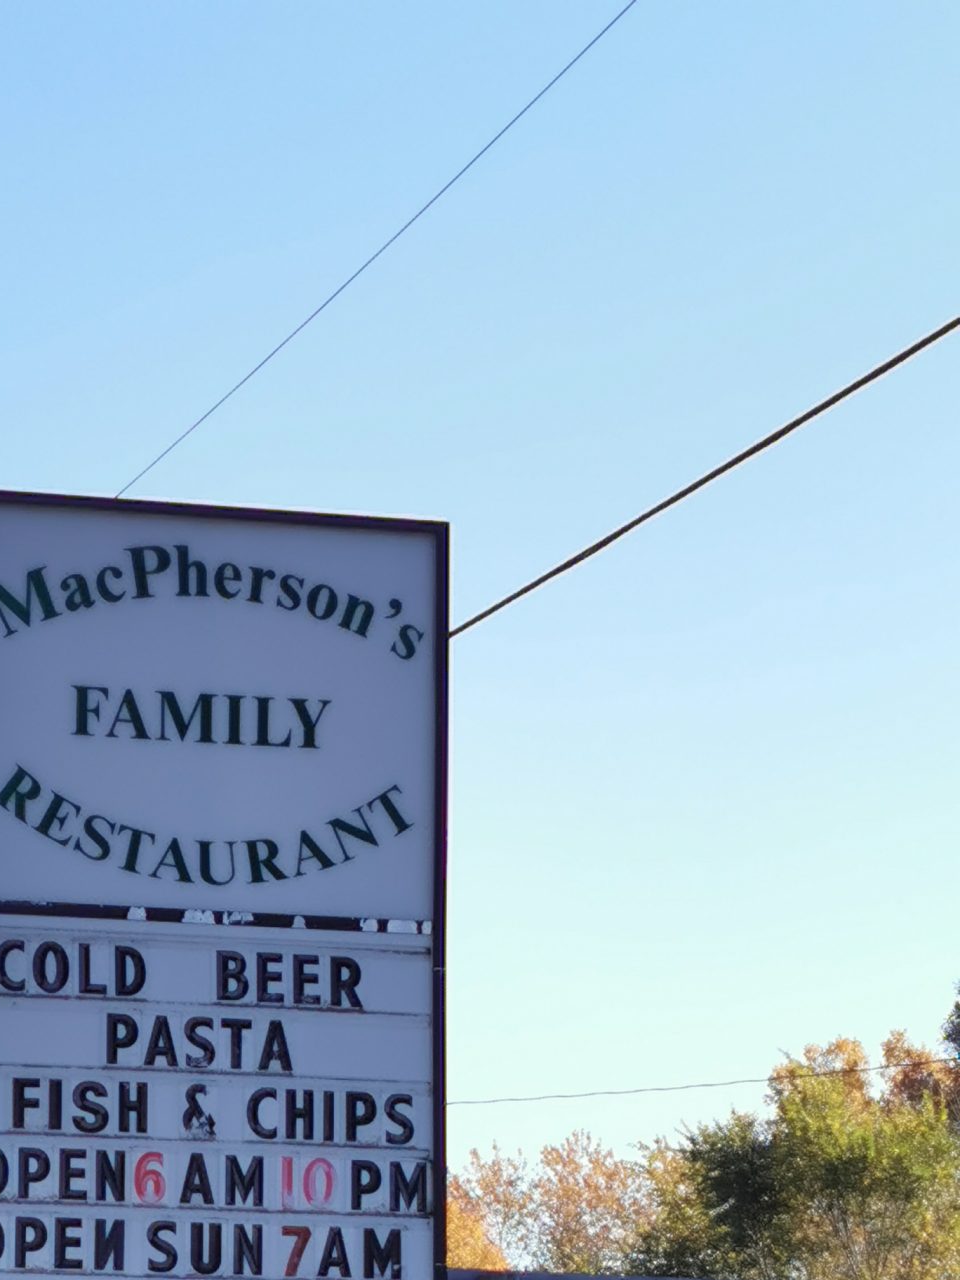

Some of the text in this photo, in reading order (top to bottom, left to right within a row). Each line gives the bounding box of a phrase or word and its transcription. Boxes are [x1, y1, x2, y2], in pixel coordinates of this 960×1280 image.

[70, 684, 332, 749] FAMILY
[215, 949, 363, 1009] BEER
[105, 1012, 294, 1072] PASTA
[11, 1077, 415, 1145] FISH & CHIPS
[146, 1220, 264, 1275] SUN
